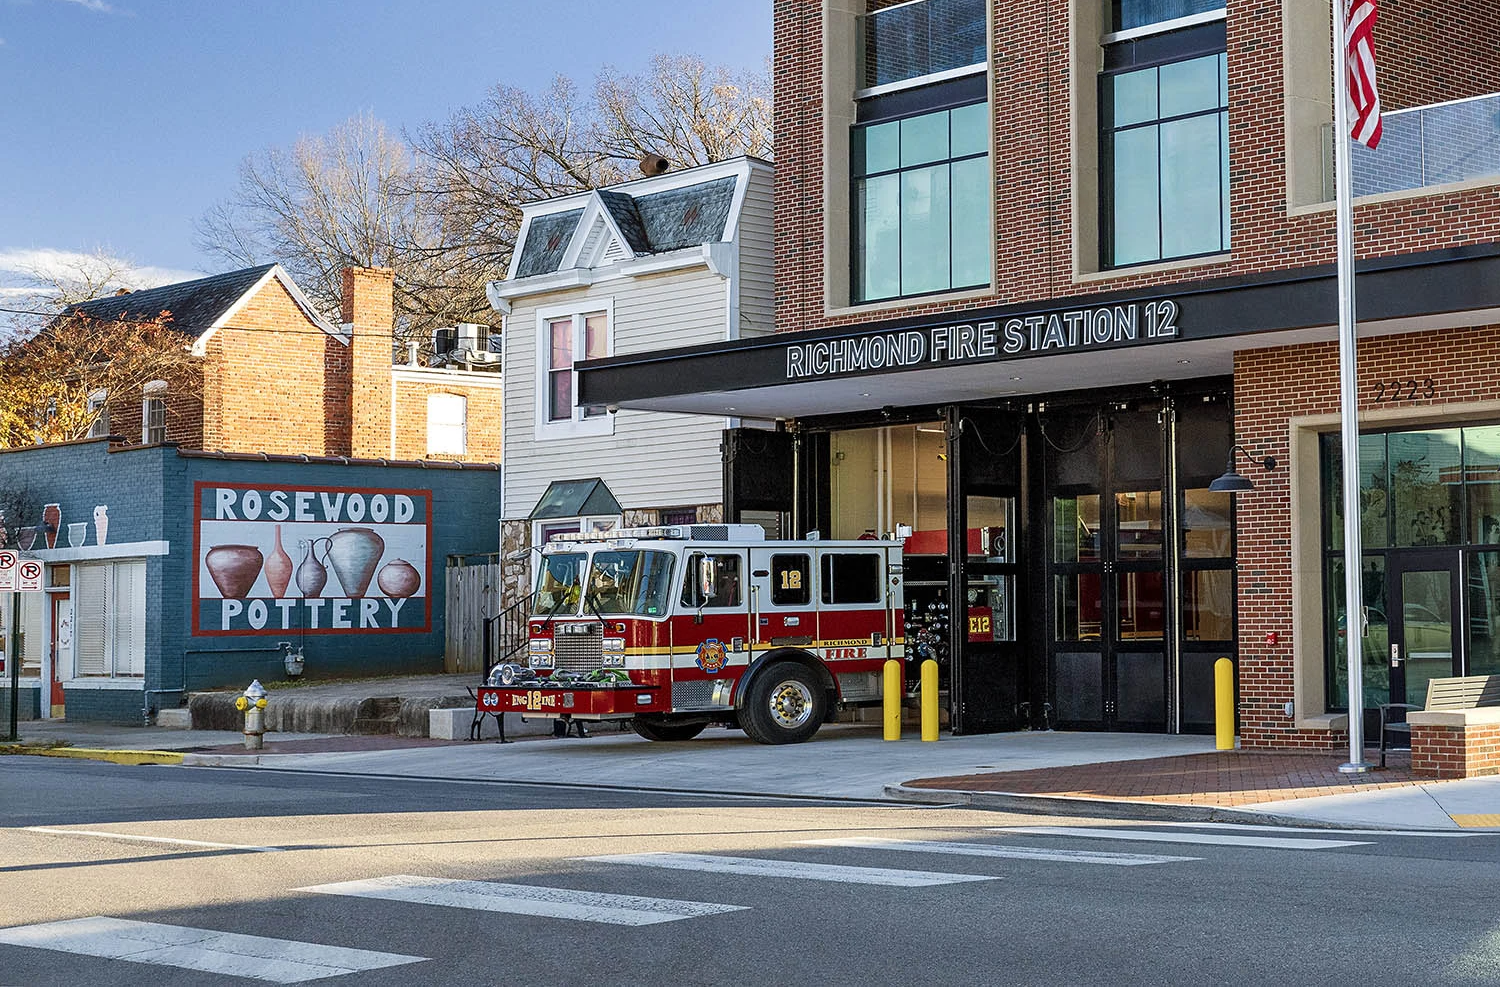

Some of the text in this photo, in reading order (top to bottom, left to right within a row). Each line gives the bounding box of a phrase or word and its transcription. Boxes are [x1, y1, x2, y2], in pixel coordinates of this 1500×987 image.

[786, 300, 1180, 378] RICHMOND FIRE STATION 12
[1374, 378, 1434, 403] 2223
[216, 488, 414, 523] ROSEWOOD
[781, 570, 801, 589] 12
[222, 598, 408, 630] POTTERY
[969, 616, 990, 633] E12
[825, 647, 867, 660] FIRE
[527, 691, 541, 710] 12
